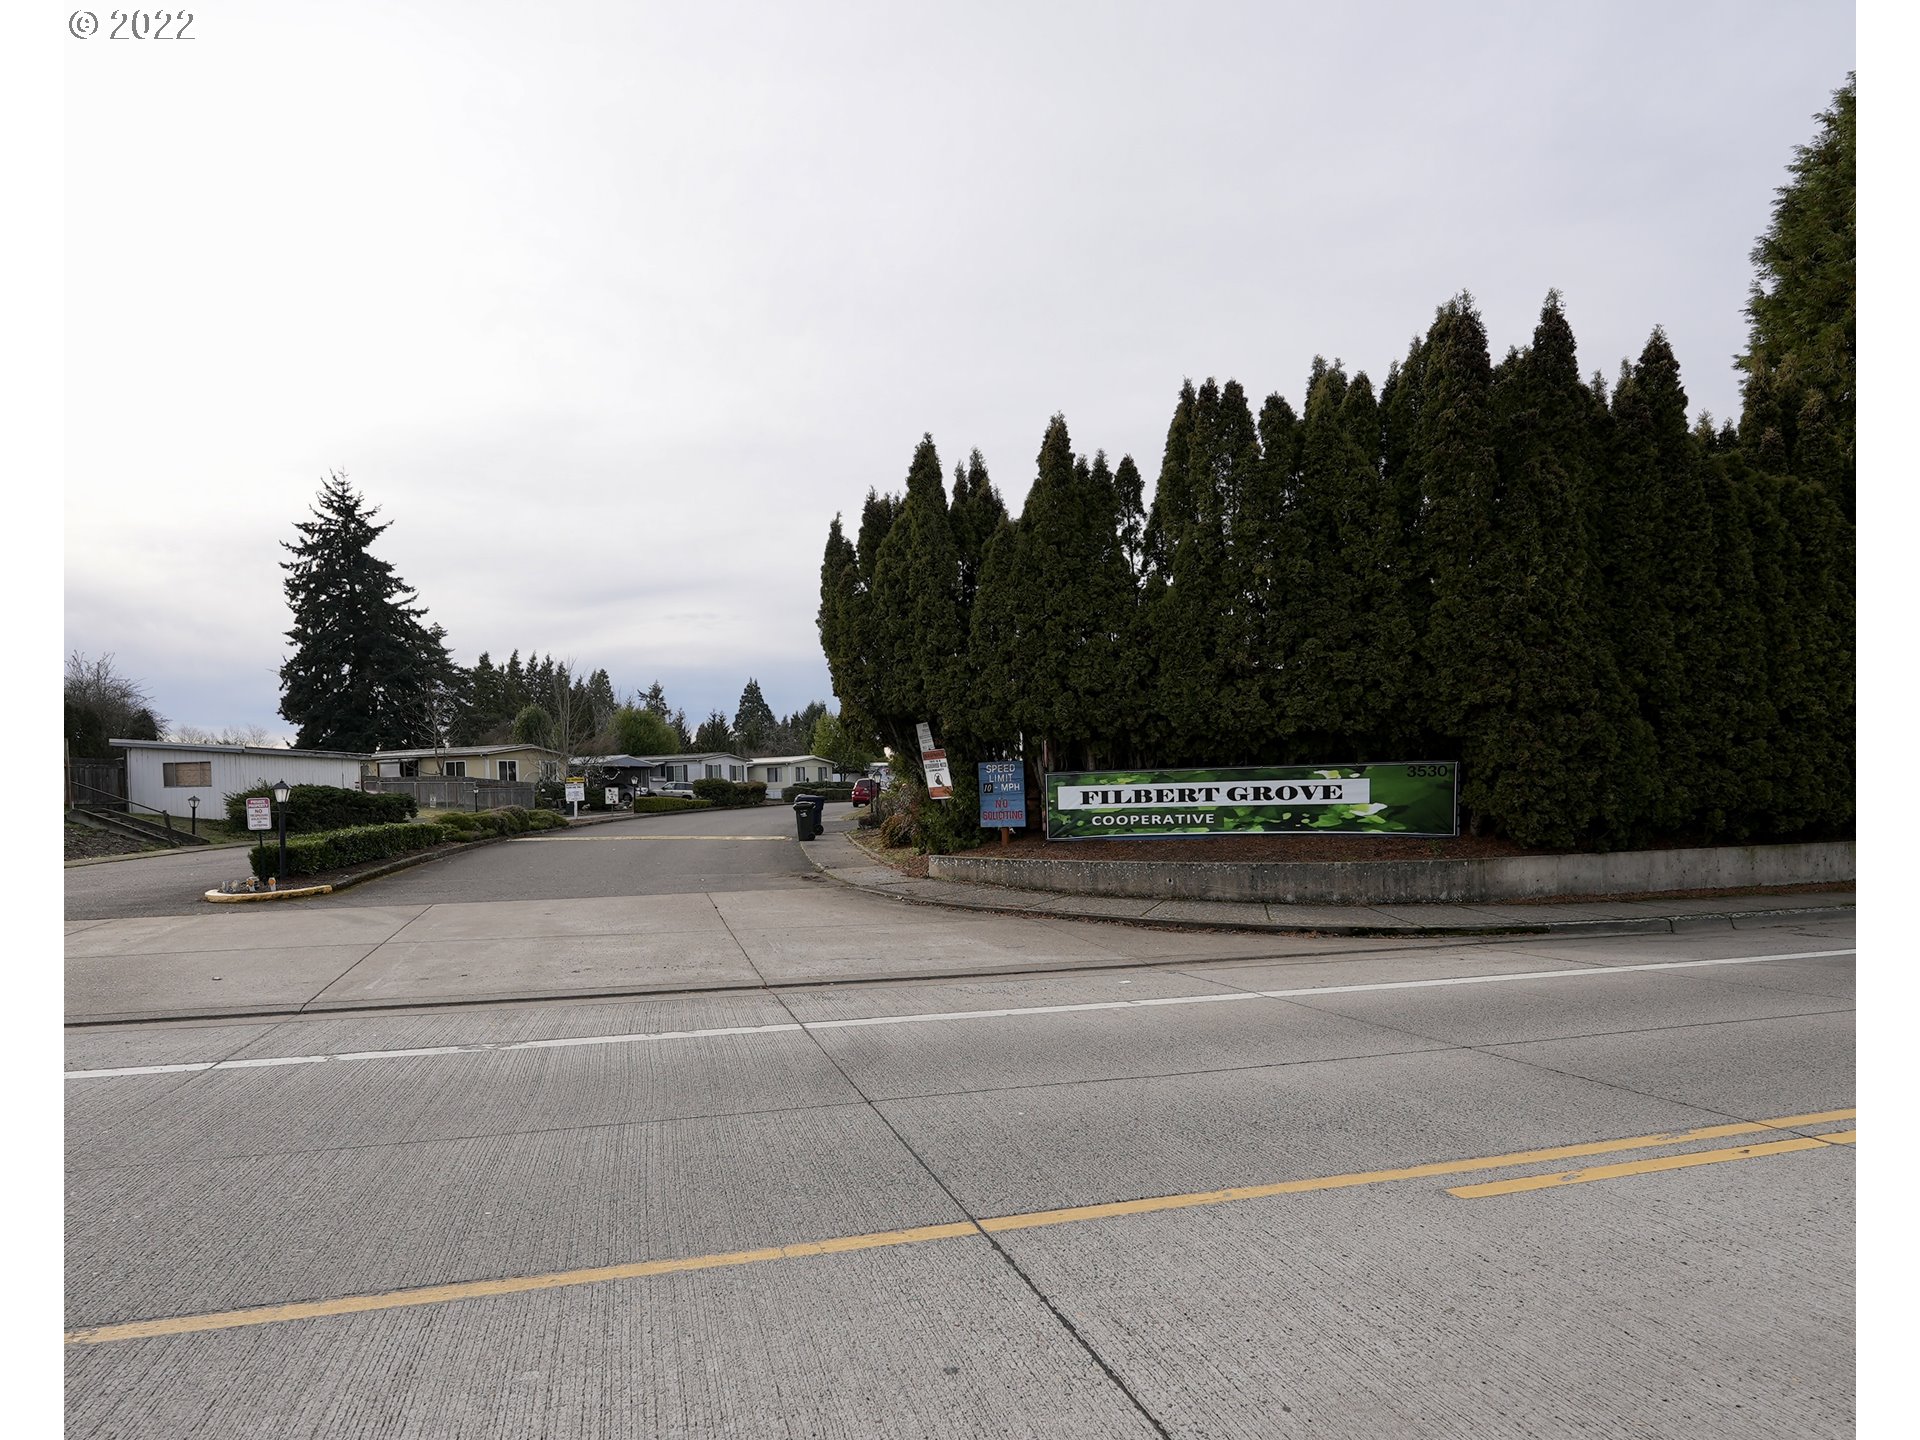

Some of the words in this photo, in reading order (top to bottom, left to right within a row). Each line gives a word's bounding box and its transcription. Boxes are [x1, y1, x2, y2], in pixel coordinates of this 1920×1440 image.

[985, 763, 1016, 774] SPEED
[1406, 765, 1449, 778] 3530
[989, 773, 1014, 783] LIMIT
[984, 784, 992, 792] 10
[1000, 783, 1021, 792] MPH
[1079, 787, 1220, 806] FILBERT
[1226, 784, 1344, 802] GROVE
[995, 799, 1009, 809] NO
[983, 810, 1024, 821] SOLICITING
[1091, 813, 1215, 826] COOPERATIVE
